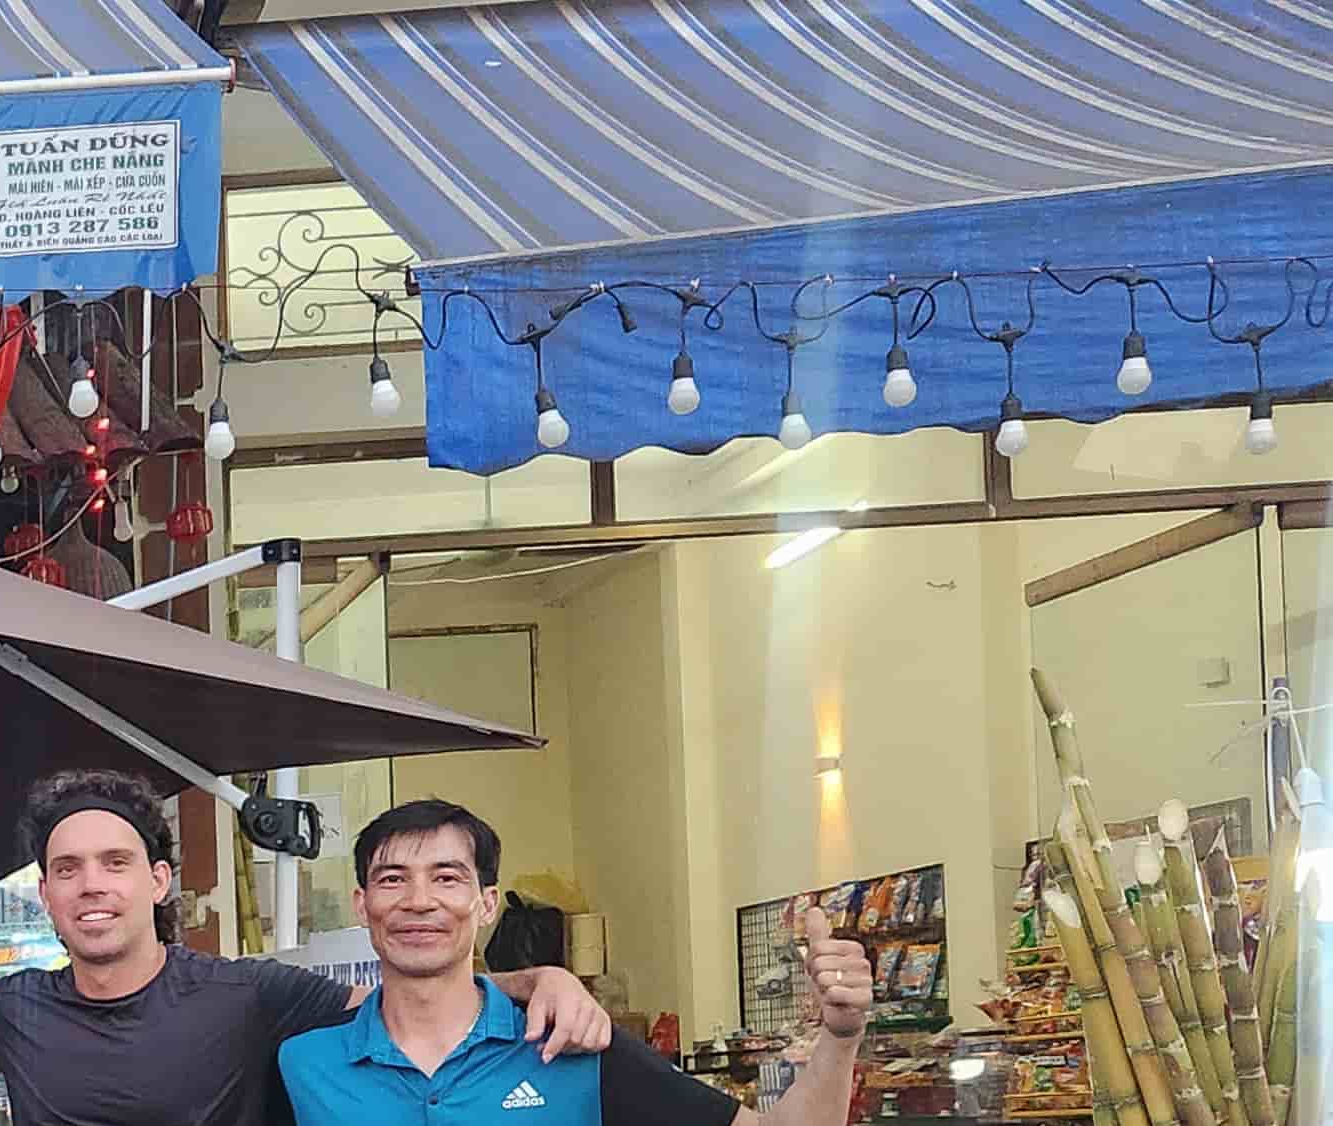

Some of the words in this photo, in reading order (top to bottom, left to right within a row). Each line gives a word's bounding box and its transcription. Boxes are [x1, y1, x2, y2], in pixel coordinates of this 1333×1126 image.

[71, 155, 106, 173] CHE
[5, 221, 60, 238] 0913
[69, 219, 109, 234] 287
[501, 1096, 546, 1109] adidas
